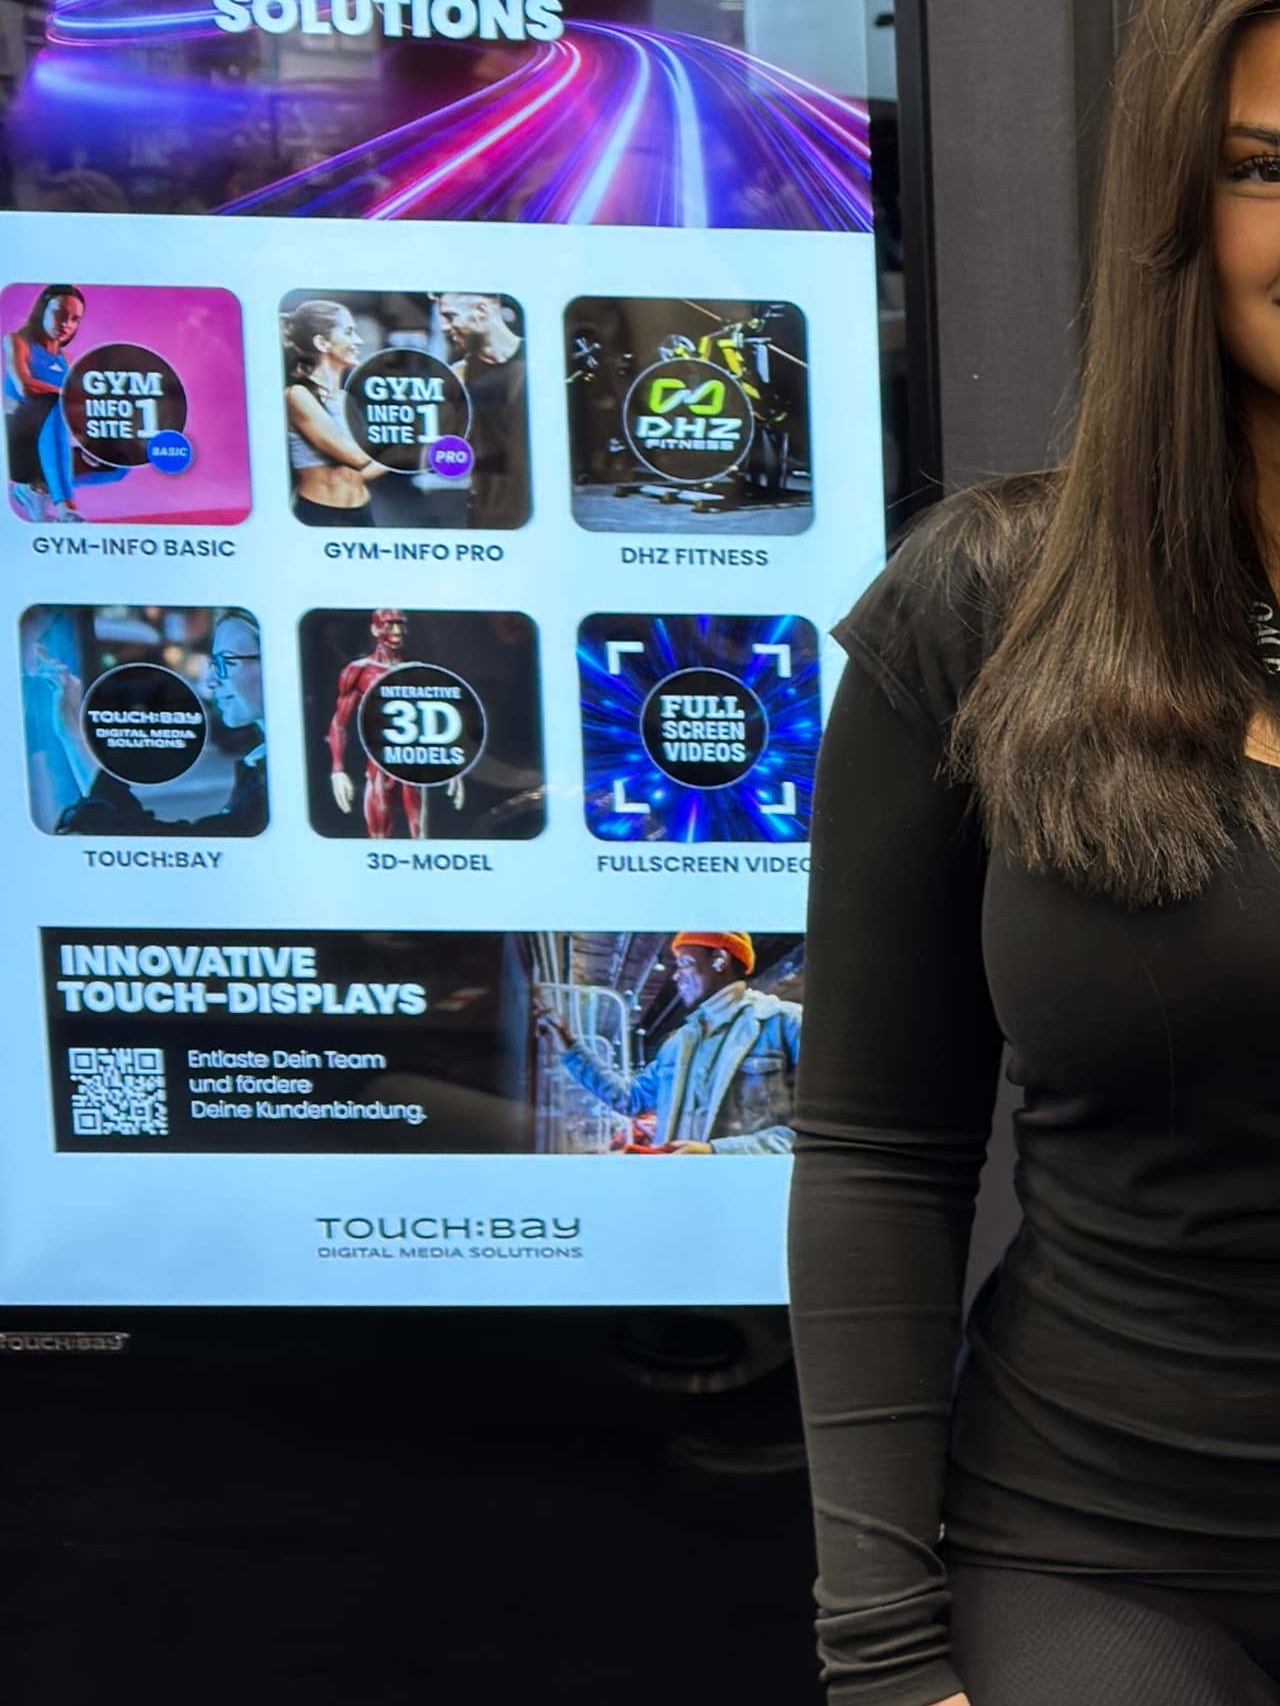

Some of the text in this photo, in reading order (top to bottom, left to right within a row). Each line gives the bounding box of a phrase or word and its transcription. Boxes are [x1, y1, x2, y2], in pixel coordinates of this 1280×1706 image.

[82, 371, 164, 396] GYM
[364, 376, 445, 402] GYM
[86, 399, 133, 417] INFO
[366, 404, 415, 423] INFO
[86, 420, 134, 438] SITE
[368, 425, 415, 444] SITE
[636, 416, 743, 440] DHZ
[152, 446, 188, 457] BASIC
[645, 439, 735, 451] FITNESS
[435, 450, 467, 463] PRO
[32, 537, 237, 558] GYM-INFO BASIC
[324, 542, 504, 562] GYM-INFO PRO
[621, 547, 769, 566] DHZ FITNESS
[380, 686, 461, 699] INTERACTIVE
[660, 695, 745, 719] FULL
[382, 700, 463, 745] 3D
[661, 720, 746, 740] SCREEN
[96, 728, 197, 739] DIGITAL MEDIA
[107, 738, 186, 749] SOLUTIONS
[663, 742, 746, 763] VIDEOS
[384, 747, 465, 765] MODELS
[83, 850, 223, 868] TOUCH:BAY
[367, 852, 493, 871] 3D-MODEL
[597, 855, 739, 873] FULLSCREEN
[59, 944, 317, 978] INNOVATIVE
[56, 980, 428, 1015] TOUCH-DISPLAYS
[187, 1050, 386, 1069] Entlaste Dein Team
[189, 1075, 313, 1094] und fördere
[190, 1100, 428, 1125] Deine Kundenbindung.
[317, 1246, 583, 1259] DIGITAL MEDIA SOLUTIONS
